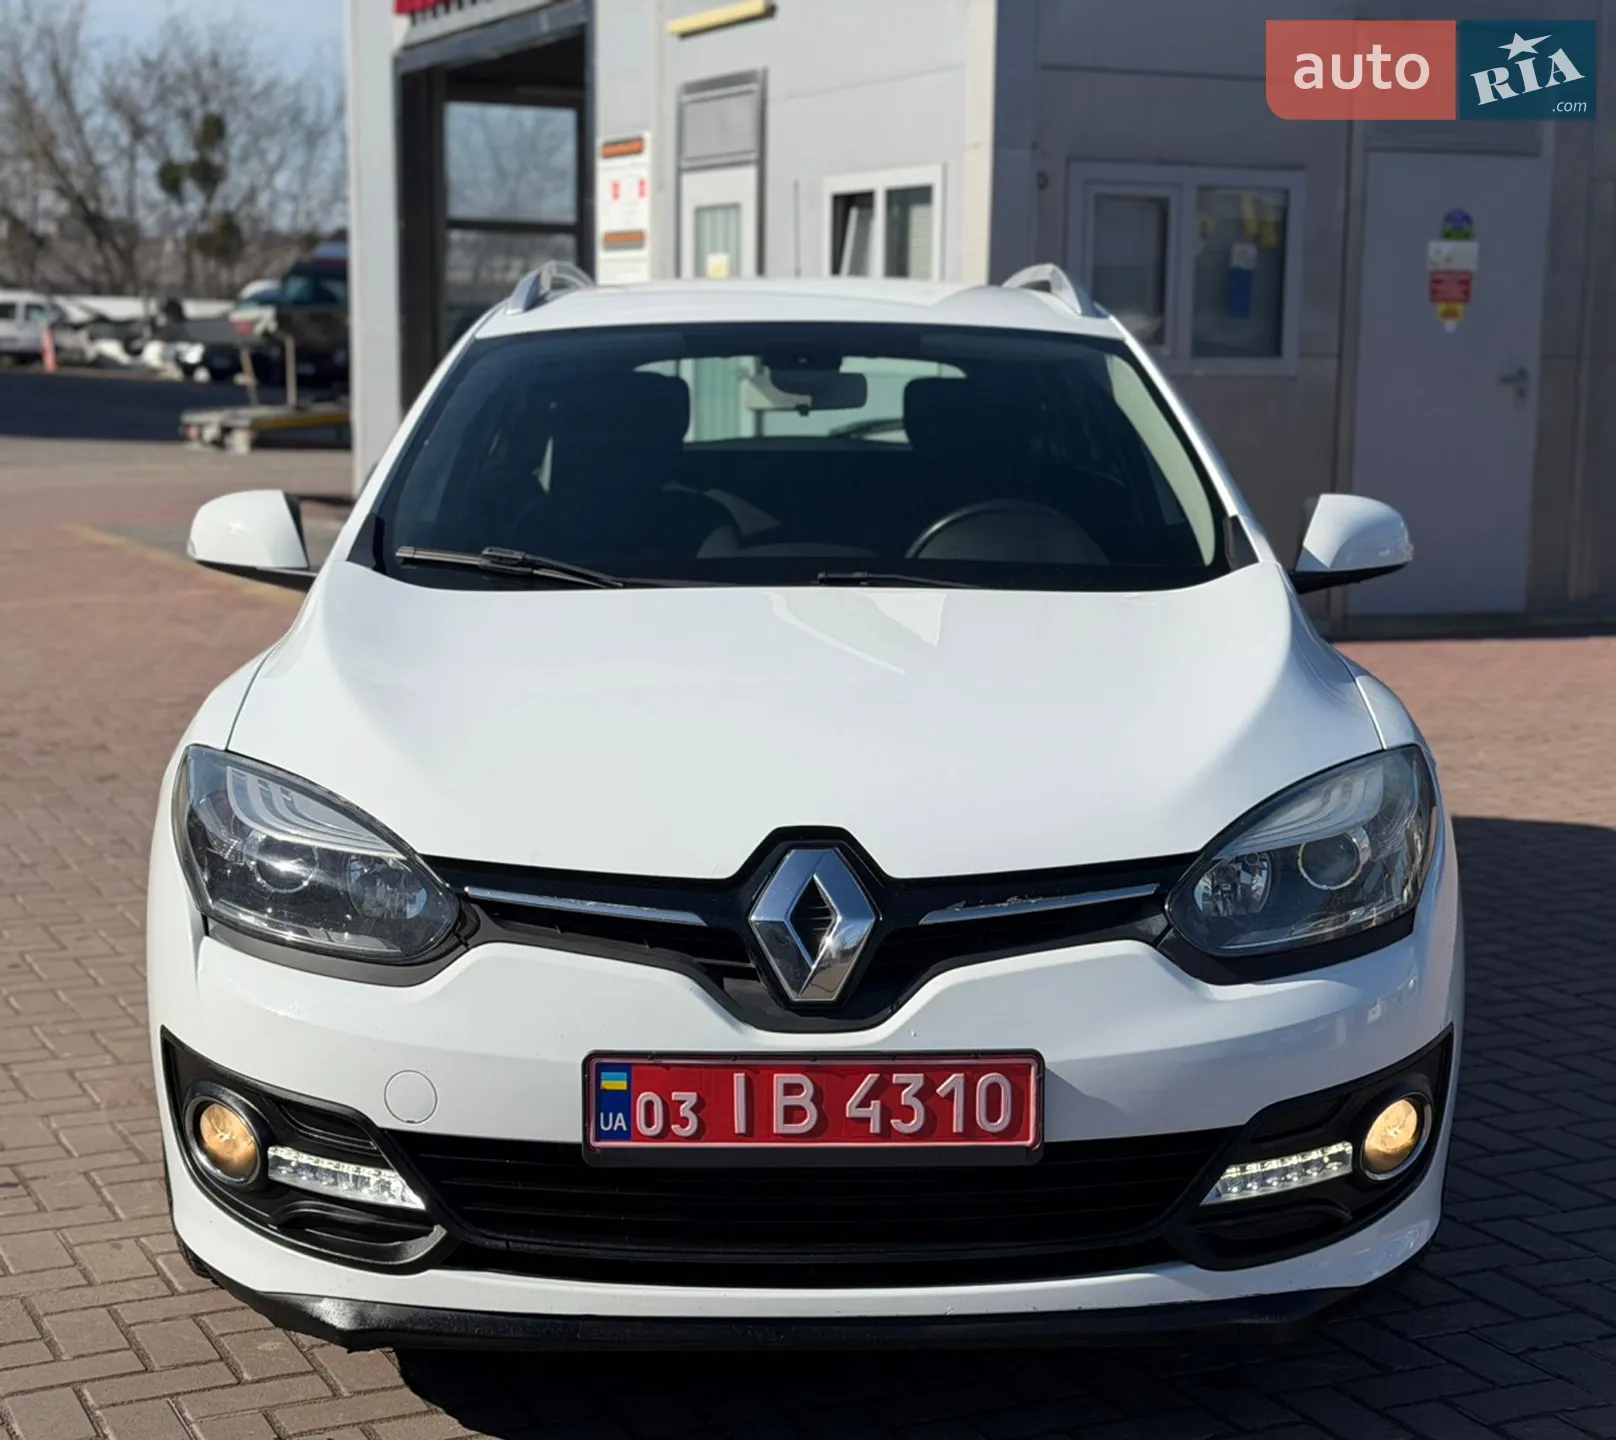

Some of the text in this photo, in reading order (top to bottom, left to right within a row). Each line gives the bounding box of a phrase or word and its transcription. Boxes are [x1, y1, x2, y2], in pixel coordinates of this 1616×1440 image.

[600, 1112, 628, 1132] UA
[635, 1091, 699, 1138] 03
[845, 1072, 1014, 1135] 4310
